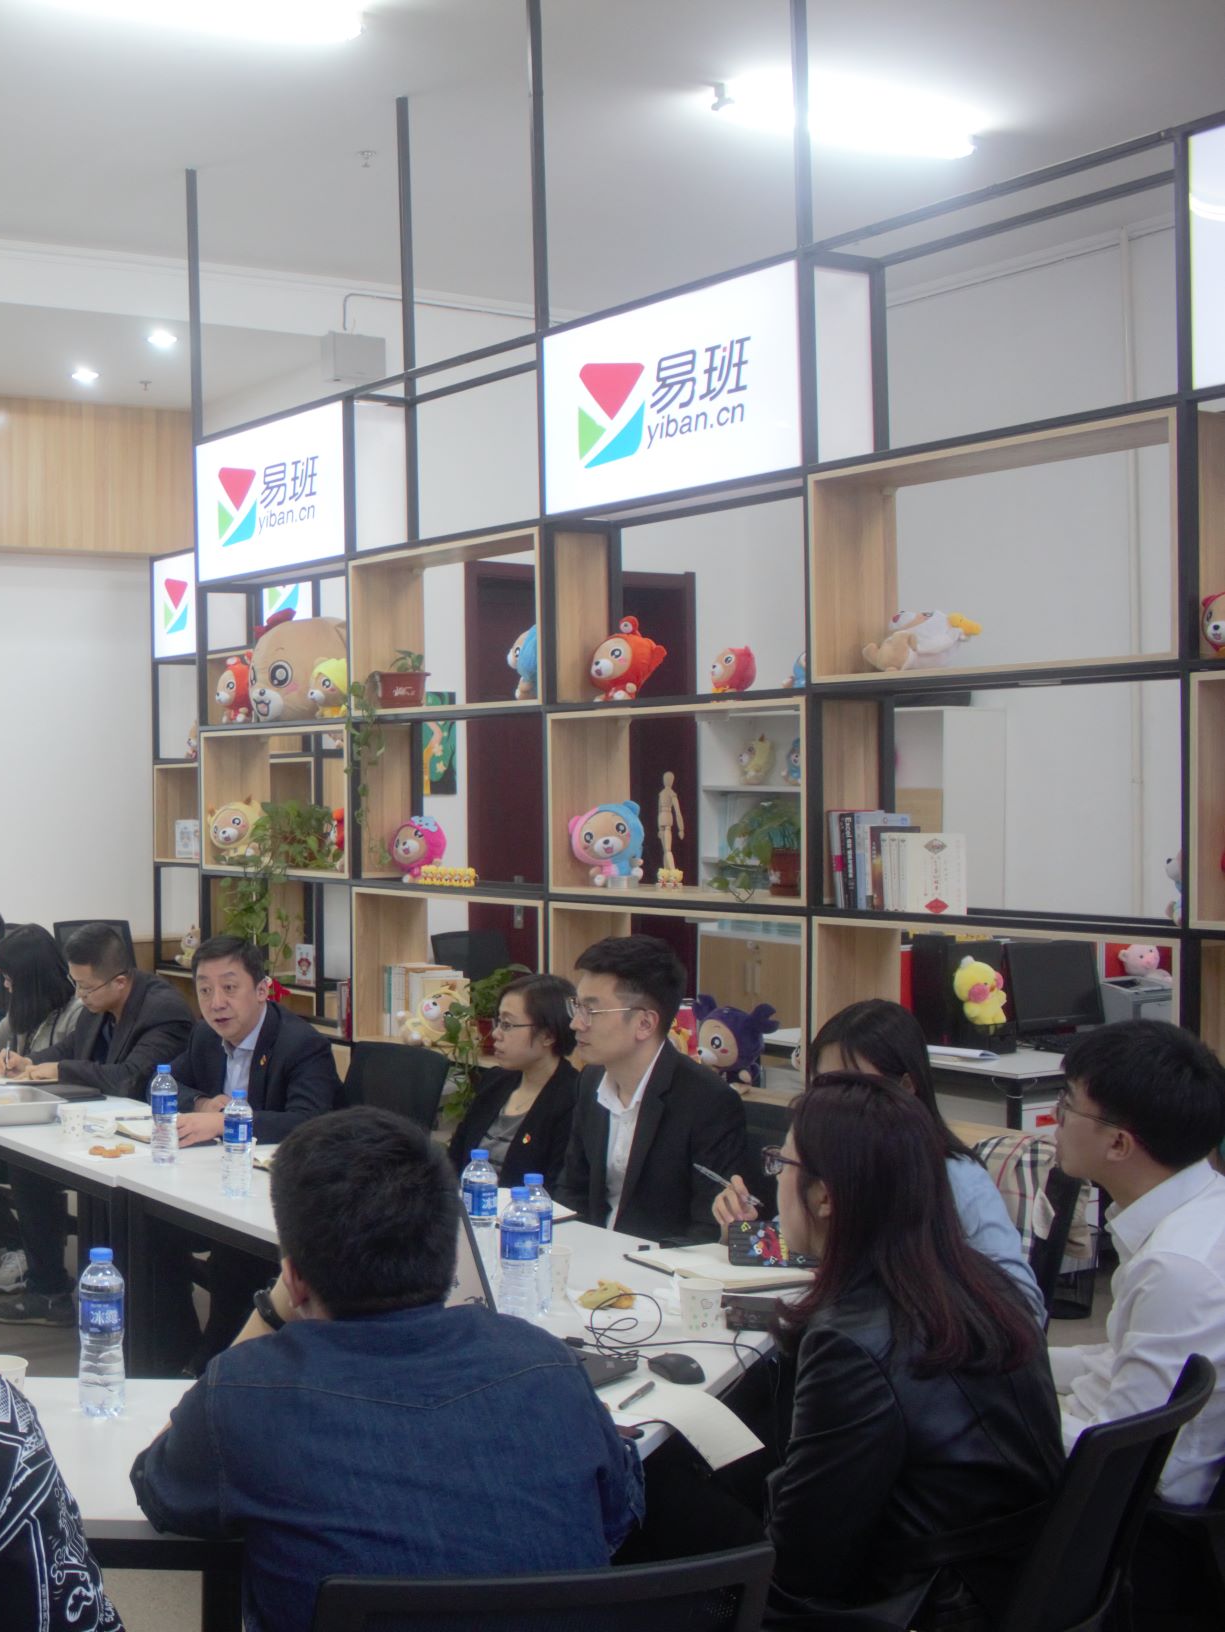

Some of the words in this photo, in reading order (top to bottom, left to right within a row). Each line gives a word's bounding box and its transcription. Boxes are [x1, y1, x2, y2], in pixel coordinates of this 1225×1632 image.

[649, 336, 752, 415] 易班
[646, 402, 745, 449] yiban.cn
[259, 455, 319, 508] 易班
[258, 504, 316, 534] yiban.cn
